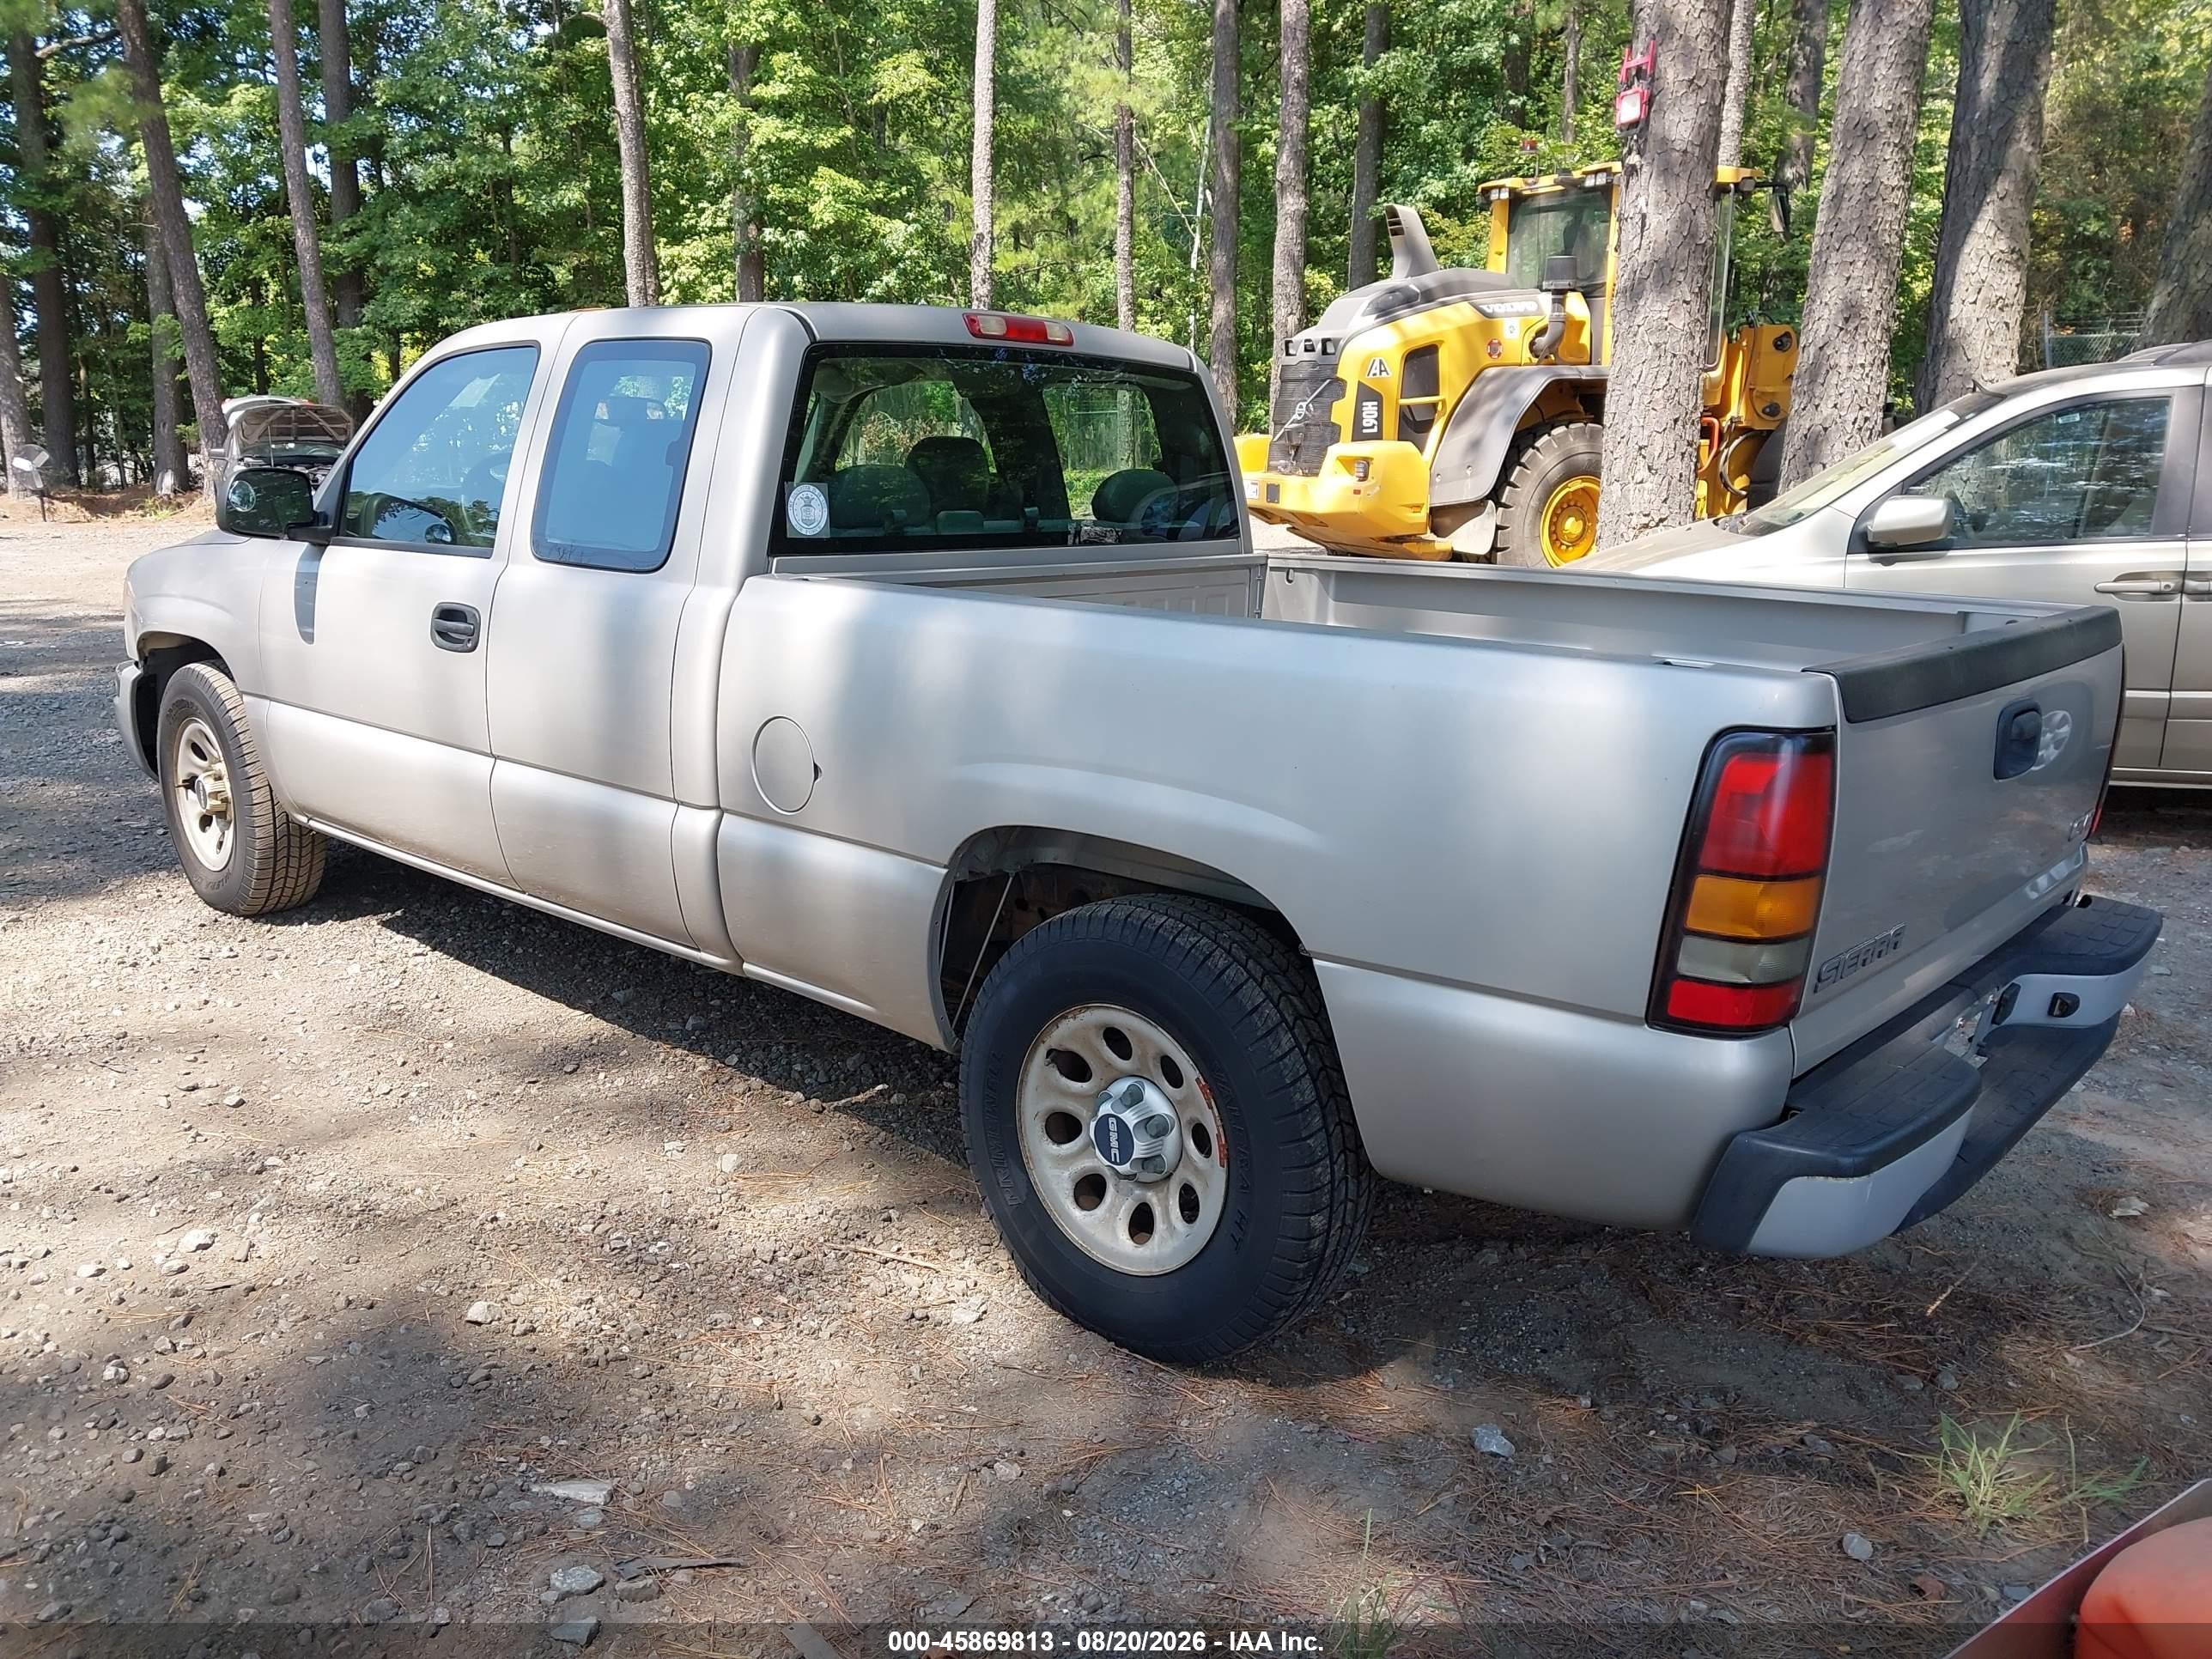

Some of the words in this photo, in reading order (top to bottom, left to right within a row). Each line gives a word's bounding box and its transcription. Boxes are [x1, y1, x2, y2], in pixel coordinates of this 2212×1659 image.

[1478, 301, 1539, 313] VOLVO
[1362, 401, 1378, 434] L90H
[1814, 921, 1907, 994] SIERRA
[1108, 1116, 1121, 1163] GMC
